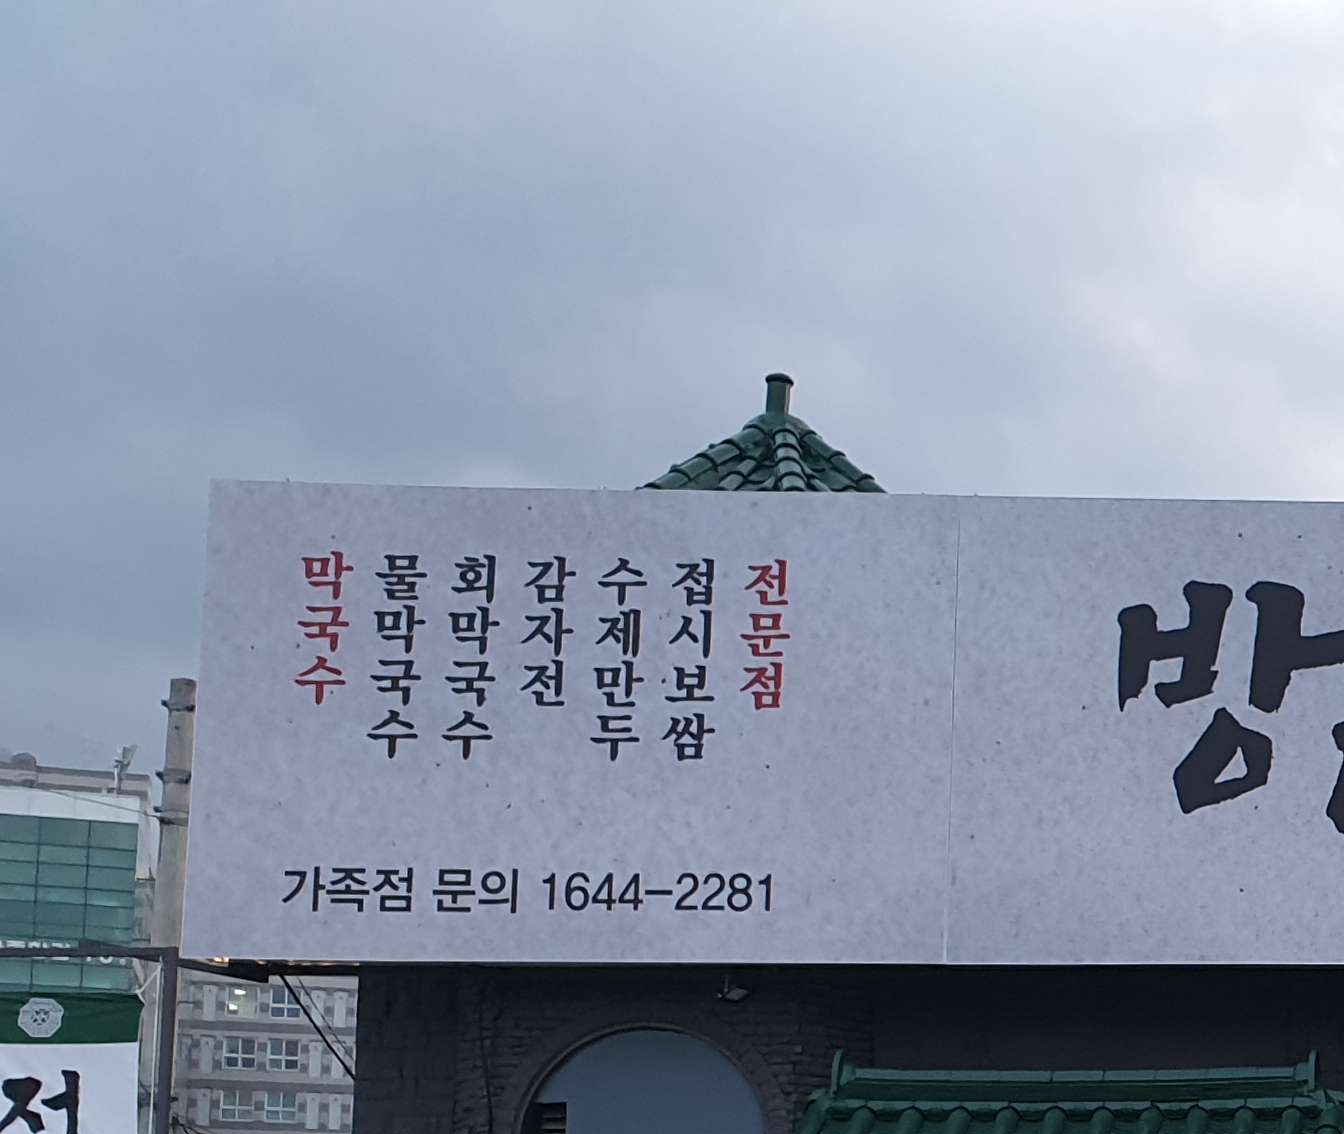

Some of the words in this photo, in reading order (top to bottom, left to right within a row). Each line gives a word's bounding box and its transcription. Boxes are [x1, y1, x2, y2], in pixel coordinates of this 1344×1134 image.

[293, 550, 355, 706] 막국수
[366, 554, 428, 760] 물막국수
[441, 553, 501, 761] 회막국수
[519, 555, 577, 707] 감자전
[589, 556, 648, 762] 수제만두
[660, 556, 716, 762] 접시보쌈
[739, 558, 791, 711] 전문점
[281, 865, 414, 913] 가족점
[432, 868, 519, 914] 문의
[542, 871, 773, 913] 1644-2281
